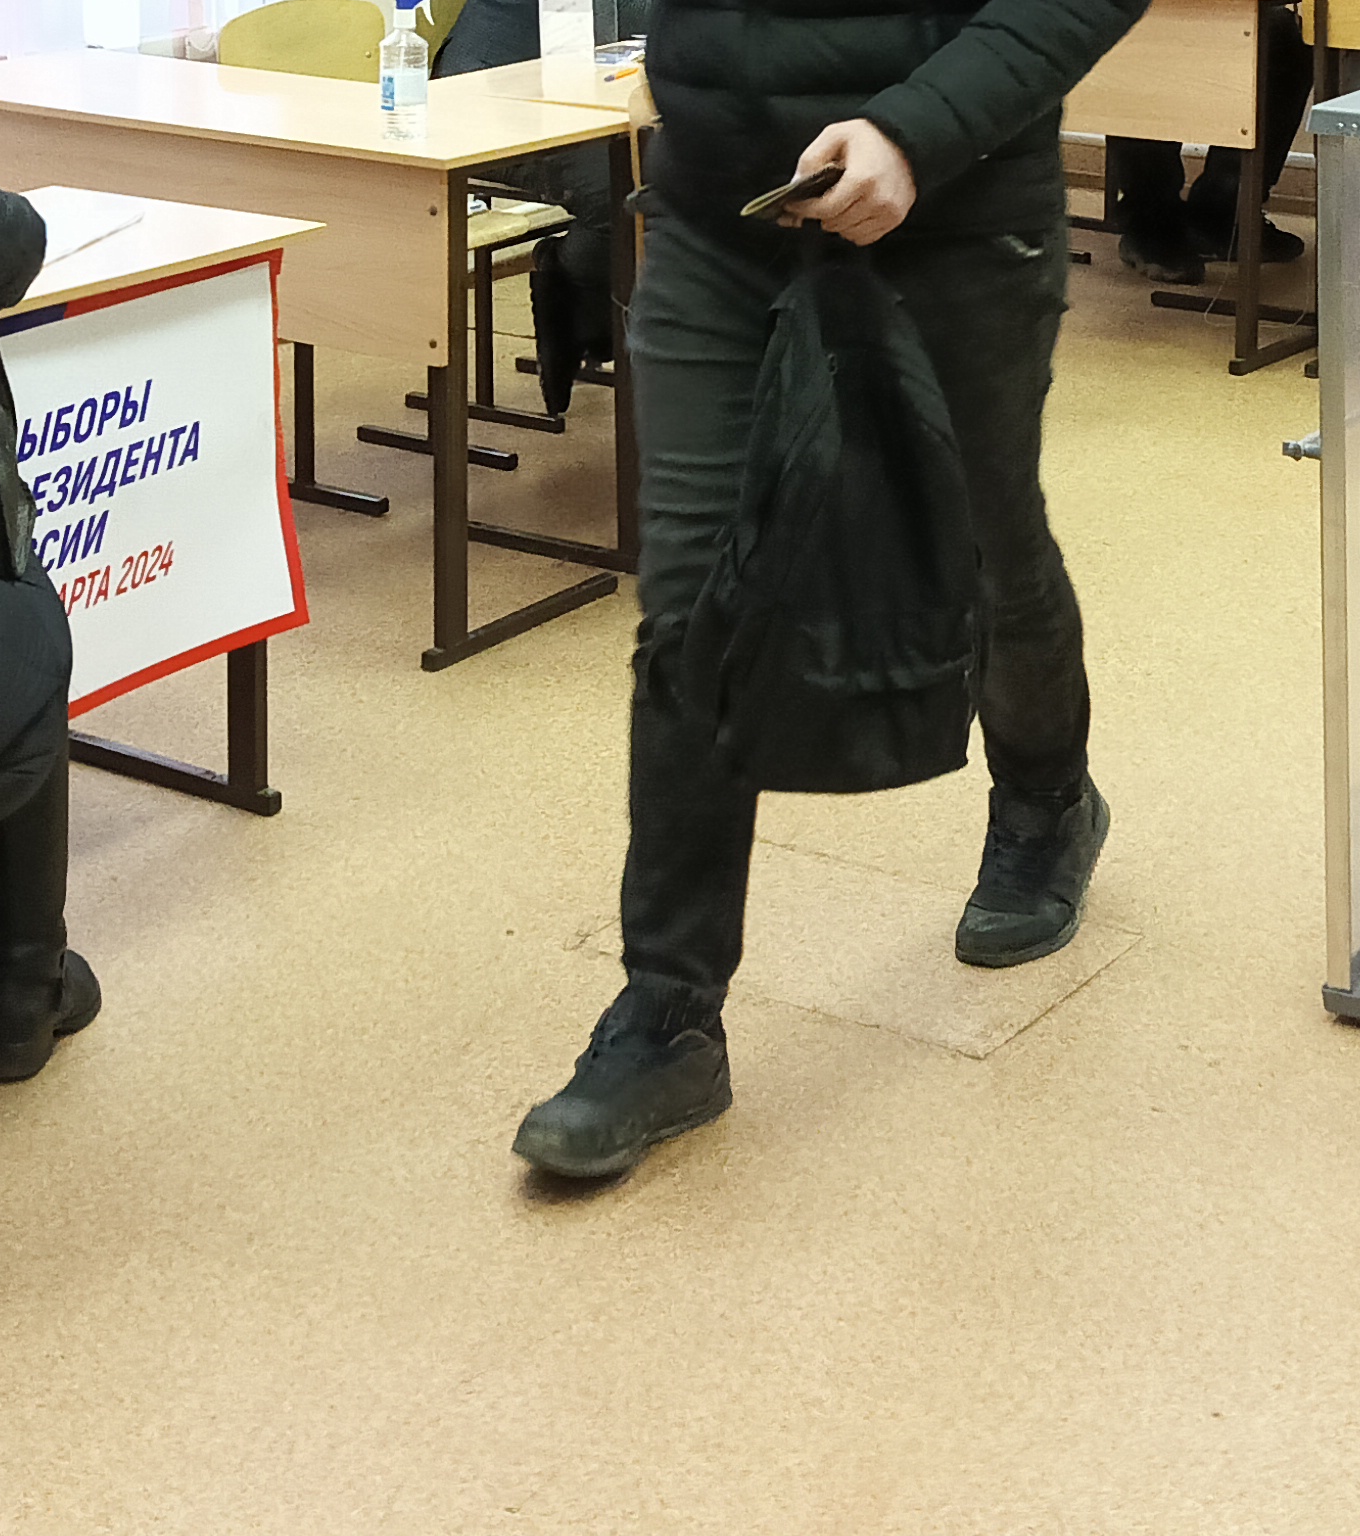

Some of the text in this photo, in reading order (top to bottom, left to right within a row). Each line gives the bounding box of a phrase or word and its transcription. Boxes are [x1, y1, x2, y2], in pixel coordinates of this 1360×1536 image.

[17, 378, 153, 463] ЫБОРЫ
[31, 420, 200, 517] ЕЗИДЕНТА
[31, 509, 110, 573] СИИ
[58, 540, 175, 617] АРТА 2024
